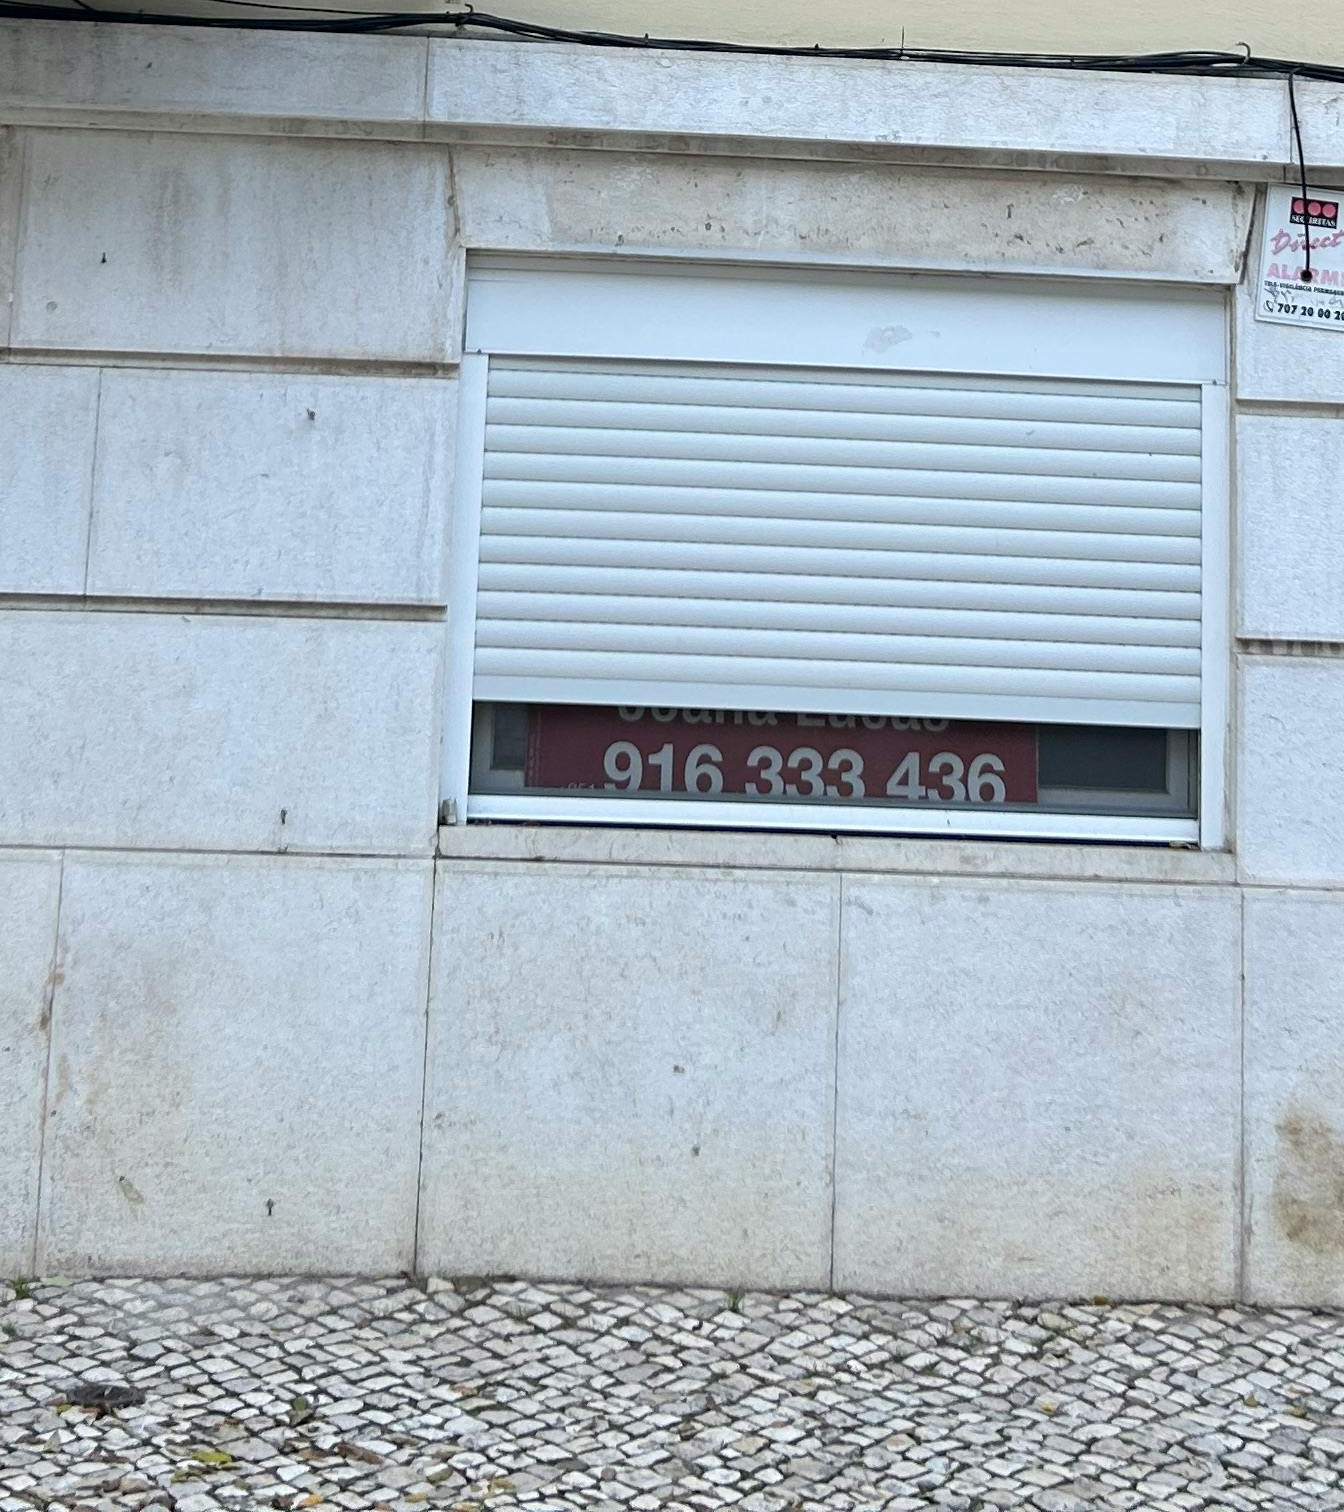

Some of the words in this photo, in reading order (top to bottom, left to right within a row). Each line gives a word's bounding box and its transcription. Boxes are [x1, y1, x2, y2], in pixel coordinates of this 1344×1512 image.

[1291, 214, 1337, 228] SECRITAS
[1277, 302, 1298, 315] 707
[1300, 305, 1314, 317] 20
[1317, 307, 1331, 319] 00
[603, 740, 725, 794] 916
[745, 745, 866, 799] 333
[886, 751, 1006, 803] 436
